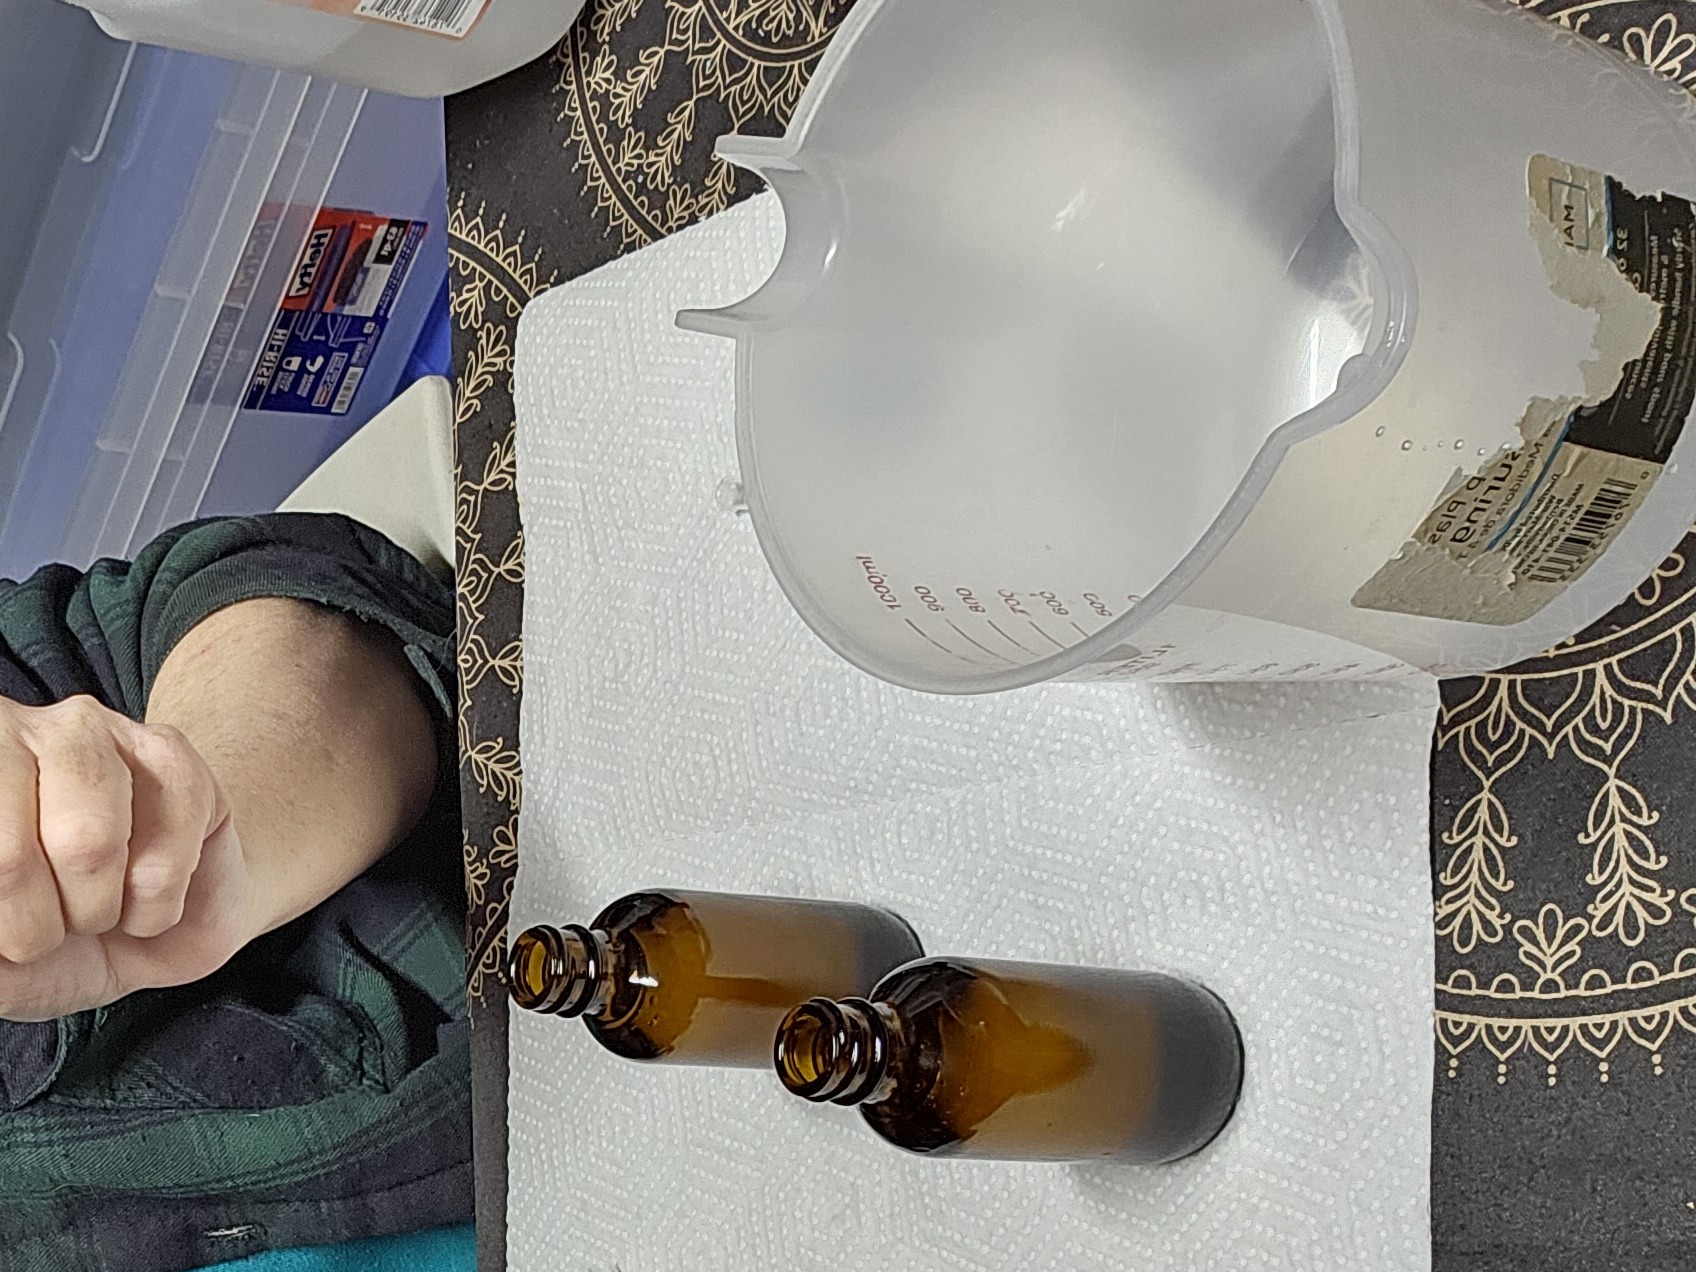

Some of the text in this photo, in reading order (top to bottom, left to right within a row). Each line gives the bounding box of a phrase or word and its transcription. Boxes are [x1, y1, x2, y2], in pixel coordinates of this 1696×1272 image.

[856, 556, 902, 609] 1000ml
[914, 586, 945, 611] 900
[955, 588, 985, 612] 800
[997, 589, 1032, 616] 700
[1039, 591, 1069, 615] 600
[1083, 593, 1113, 617] 500
